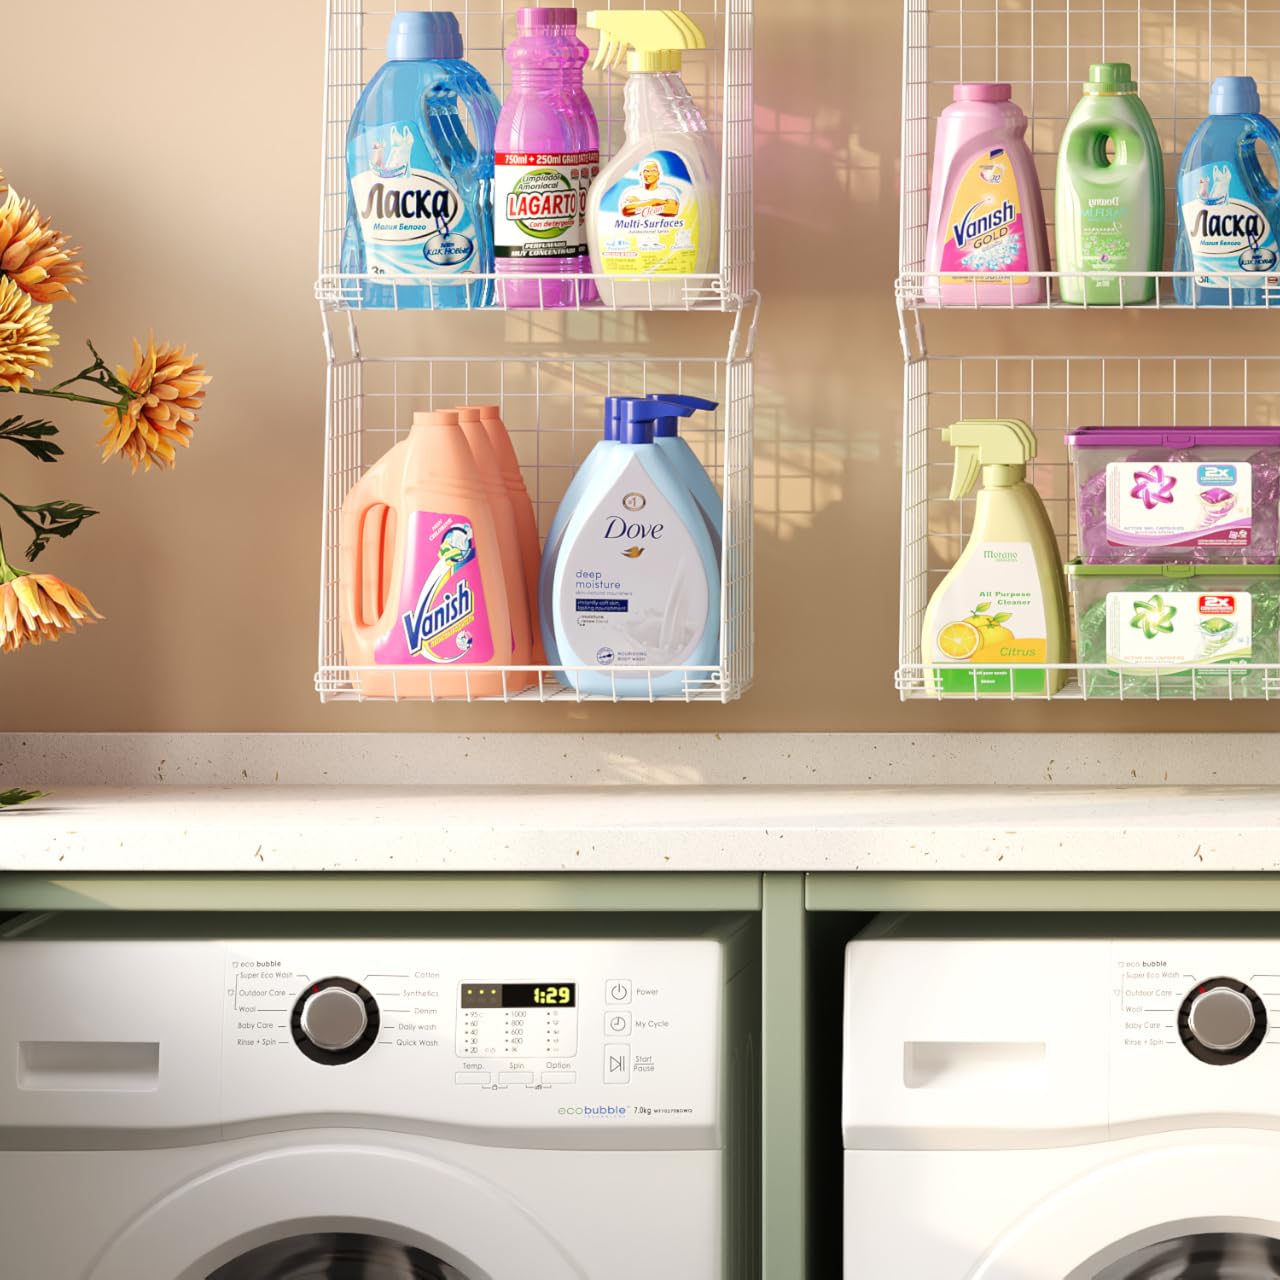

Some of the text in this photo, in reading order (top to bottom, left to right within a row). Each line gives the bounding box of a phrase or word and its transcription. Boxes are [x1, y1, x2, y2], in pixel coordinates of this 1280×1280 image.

[505, 155, 561, 164] 750ml 250ml
[362, 183, 449, 219] Ласка
[509, 193, 576, 216] LAGARTO
[615, 219, 684, 228] Multi-Surfaces
[954, 200, 1013, 245] Vanish
[1191, 210, 1259, 237] Ласка
[973, 227, 1009, 249] GOLD
[604, 515, 663, 539] Dove
[576, 570, 602, 580] deep
[576, 580, 621, 589] moisture
[404, 575, 469, 651] Vanish
[1000, 647, 1036, 656] Citrus
[240, 972, 259, 980] Super
[239, 989, 267, 997] Outdoor
[403, 990, 439, 998] Synthetics
[533, 987, 570, 1004] 1:29
[636, 988, 658, 996] Power
[237, 1022, 255, 1030] Baby
[398, 1024, 417, 1032] Daily
[635, 1020, 669, 1028] My Cycle
[262, 1039, 277, 1047] Spin
[396, 1039, 417, 1047] Quick
[635, 1055, 652, 1063] Start
[463, 1062, 571, 1070] Temp. Spin Option
[634, 1064, 655, 1072] Pause
[634, 1107, 651, 1115] 7.0kg
